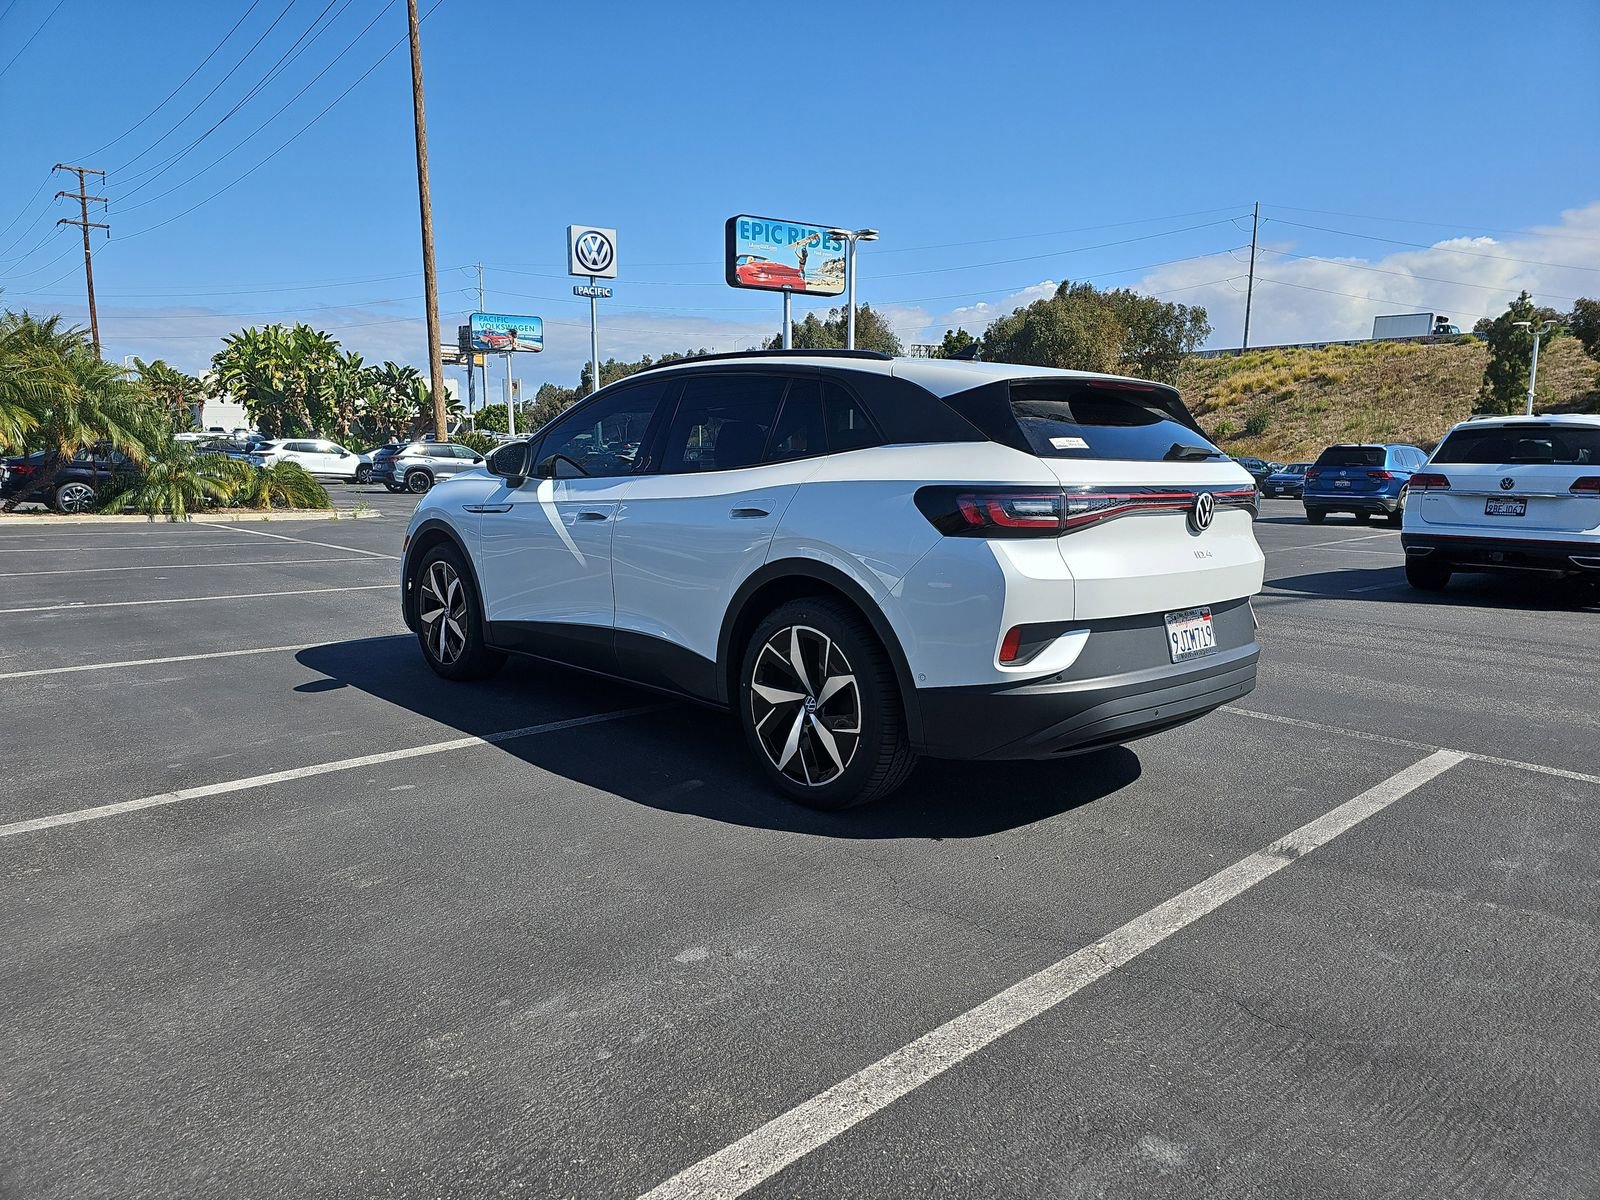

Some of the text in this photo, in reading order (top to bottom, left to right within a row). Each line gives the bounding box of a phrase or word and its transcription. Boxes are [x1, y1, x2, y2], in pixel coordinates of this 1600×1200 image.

[740, 221, 843, 252] EPIC RIDES
[578, 286, 611, 297] PACIFIC
[478, 315, 509, 324] PACIFIC
[480, 322, 535, 332] VOLKSWAGEN
[1197, 493, 1214, 529] VW
[1171, 625, 1212, 654] 9JIM719
